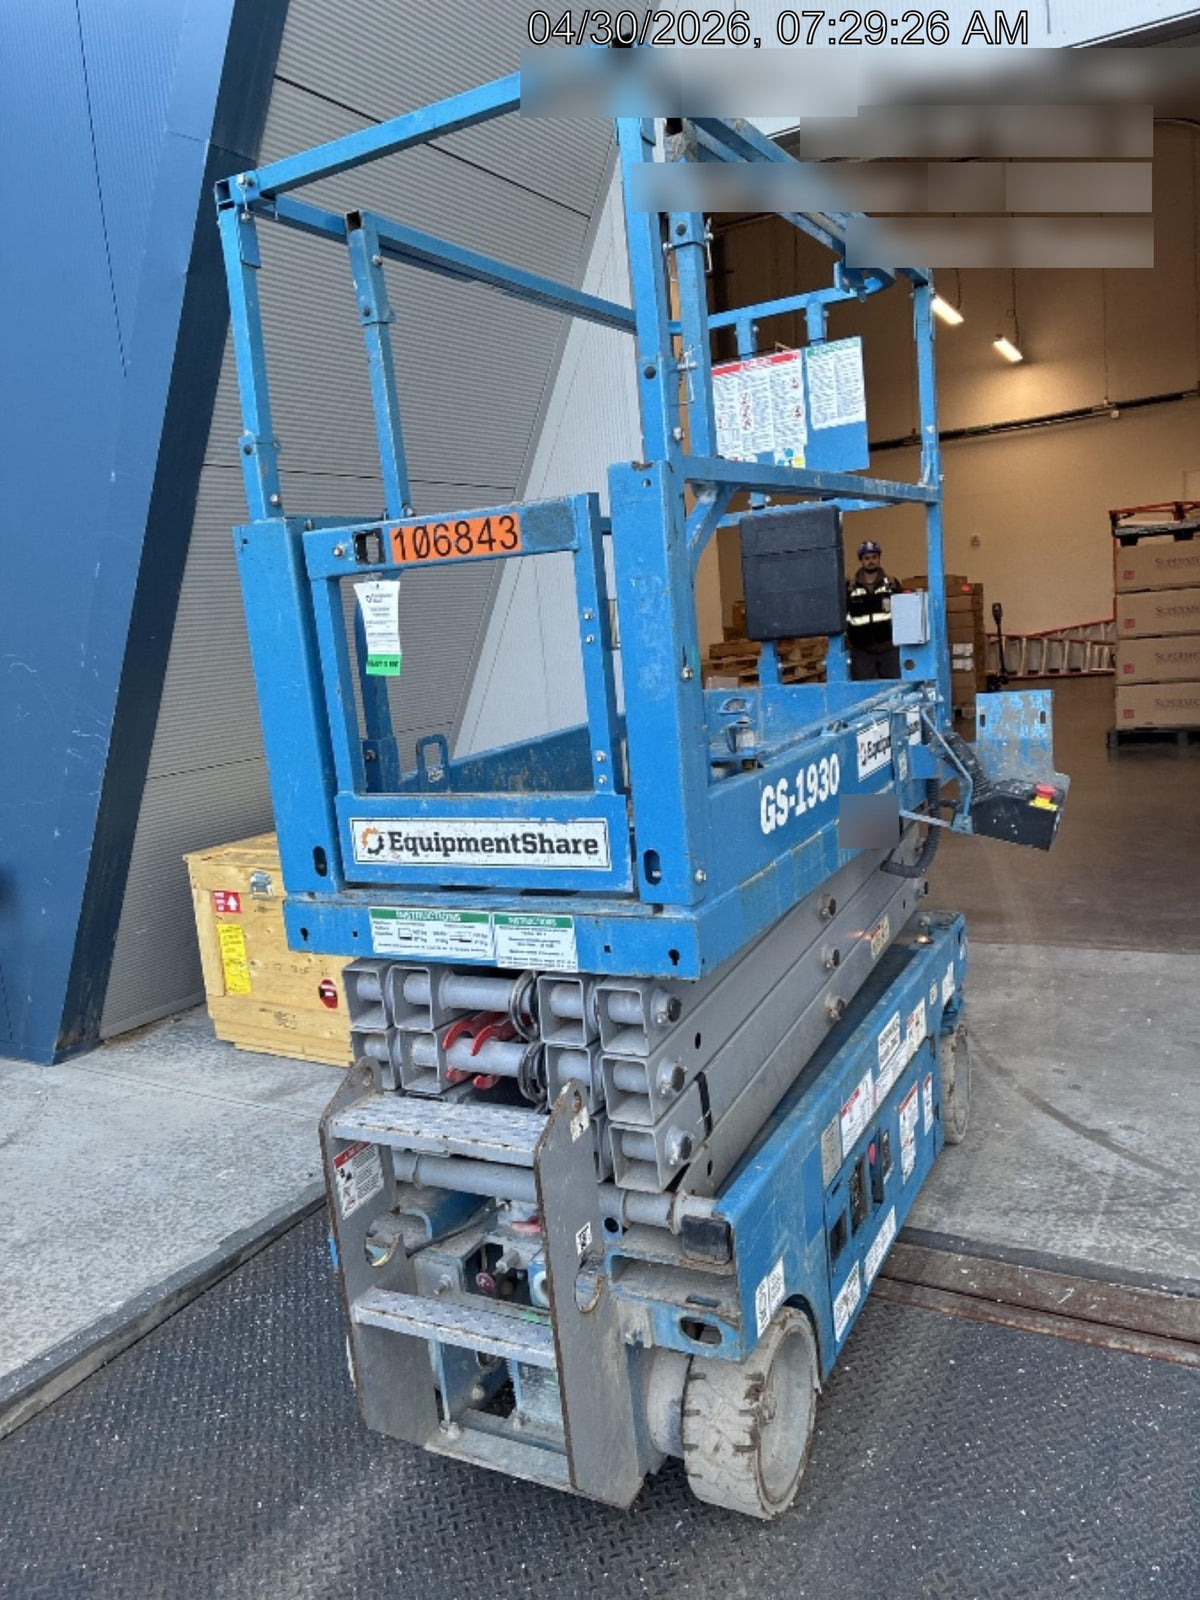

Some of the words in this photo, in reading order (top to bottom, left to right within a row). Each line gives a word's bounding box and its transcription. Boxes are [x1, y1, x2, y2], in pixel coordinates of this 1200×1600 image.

[394, 515, 520, 561] 106843
[760, 753, 840, 834] GS-1930
[387, 831, 599, 857] EquipmentShare
